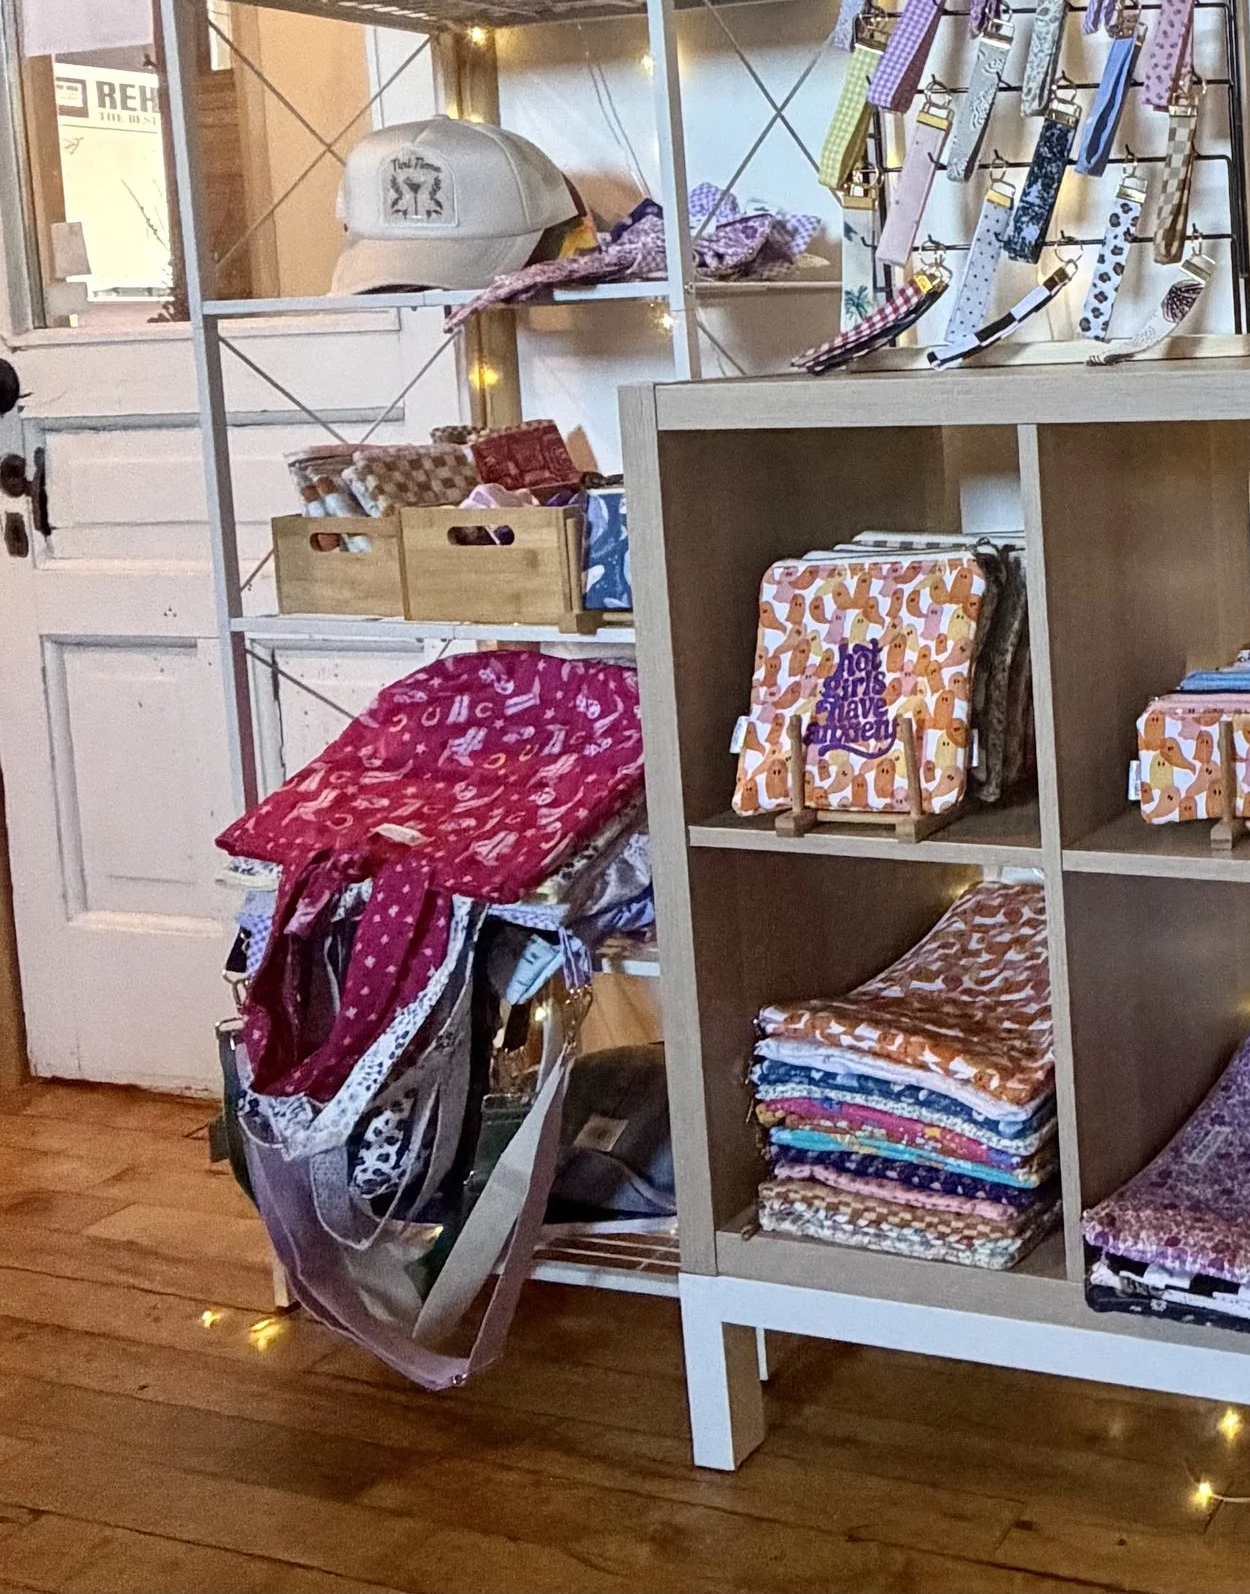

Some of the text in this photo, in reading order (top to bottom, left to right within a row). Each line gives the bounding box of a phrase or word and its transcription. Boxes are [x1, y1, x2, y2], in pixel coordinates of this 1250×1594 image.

[838, 637, 884, 677] hot
[820, 669, 888, 704] girls
[815, 696, 889, 727] have
[802, 715, 899, 760] anxiety
